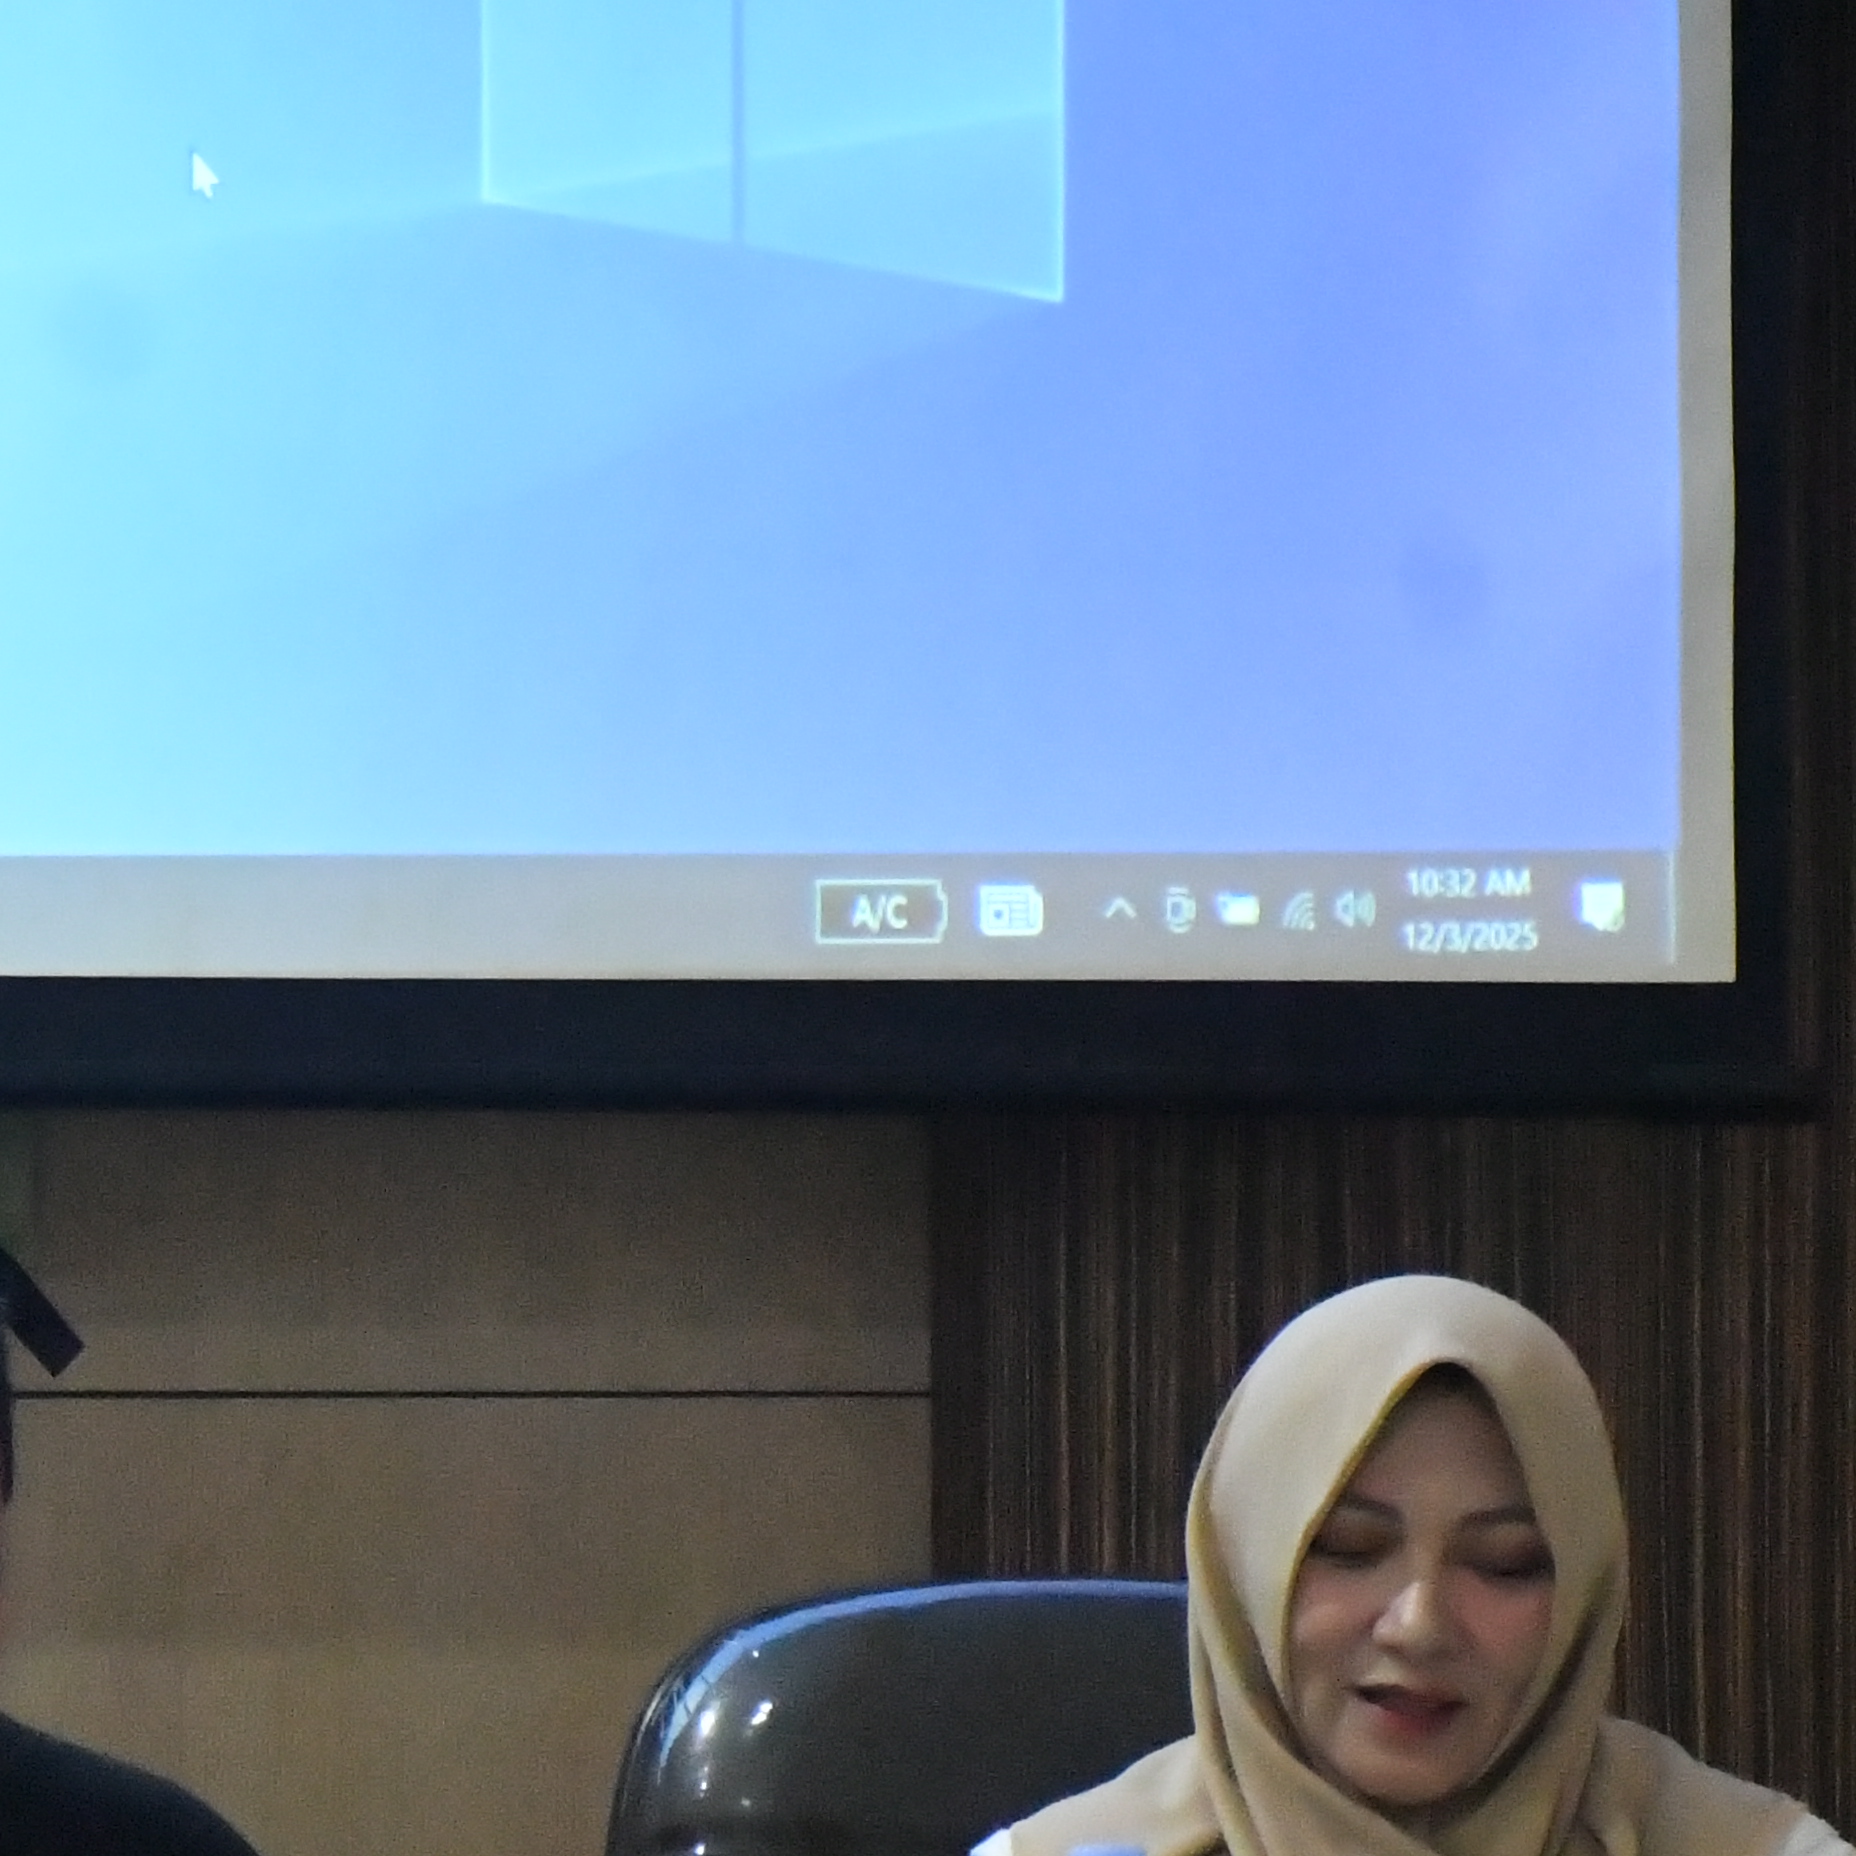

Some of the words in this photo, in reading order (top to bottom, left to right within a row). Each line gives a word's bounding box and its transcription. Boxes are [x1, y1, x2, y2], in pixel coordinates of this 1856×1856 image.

[1407, 867, 1477, 898] 10:32
[1484, 867, 1531, 897] AM
[851, 893, 909, 934] A/C
[1403, 921, 1539, 954] 12/3/2025
